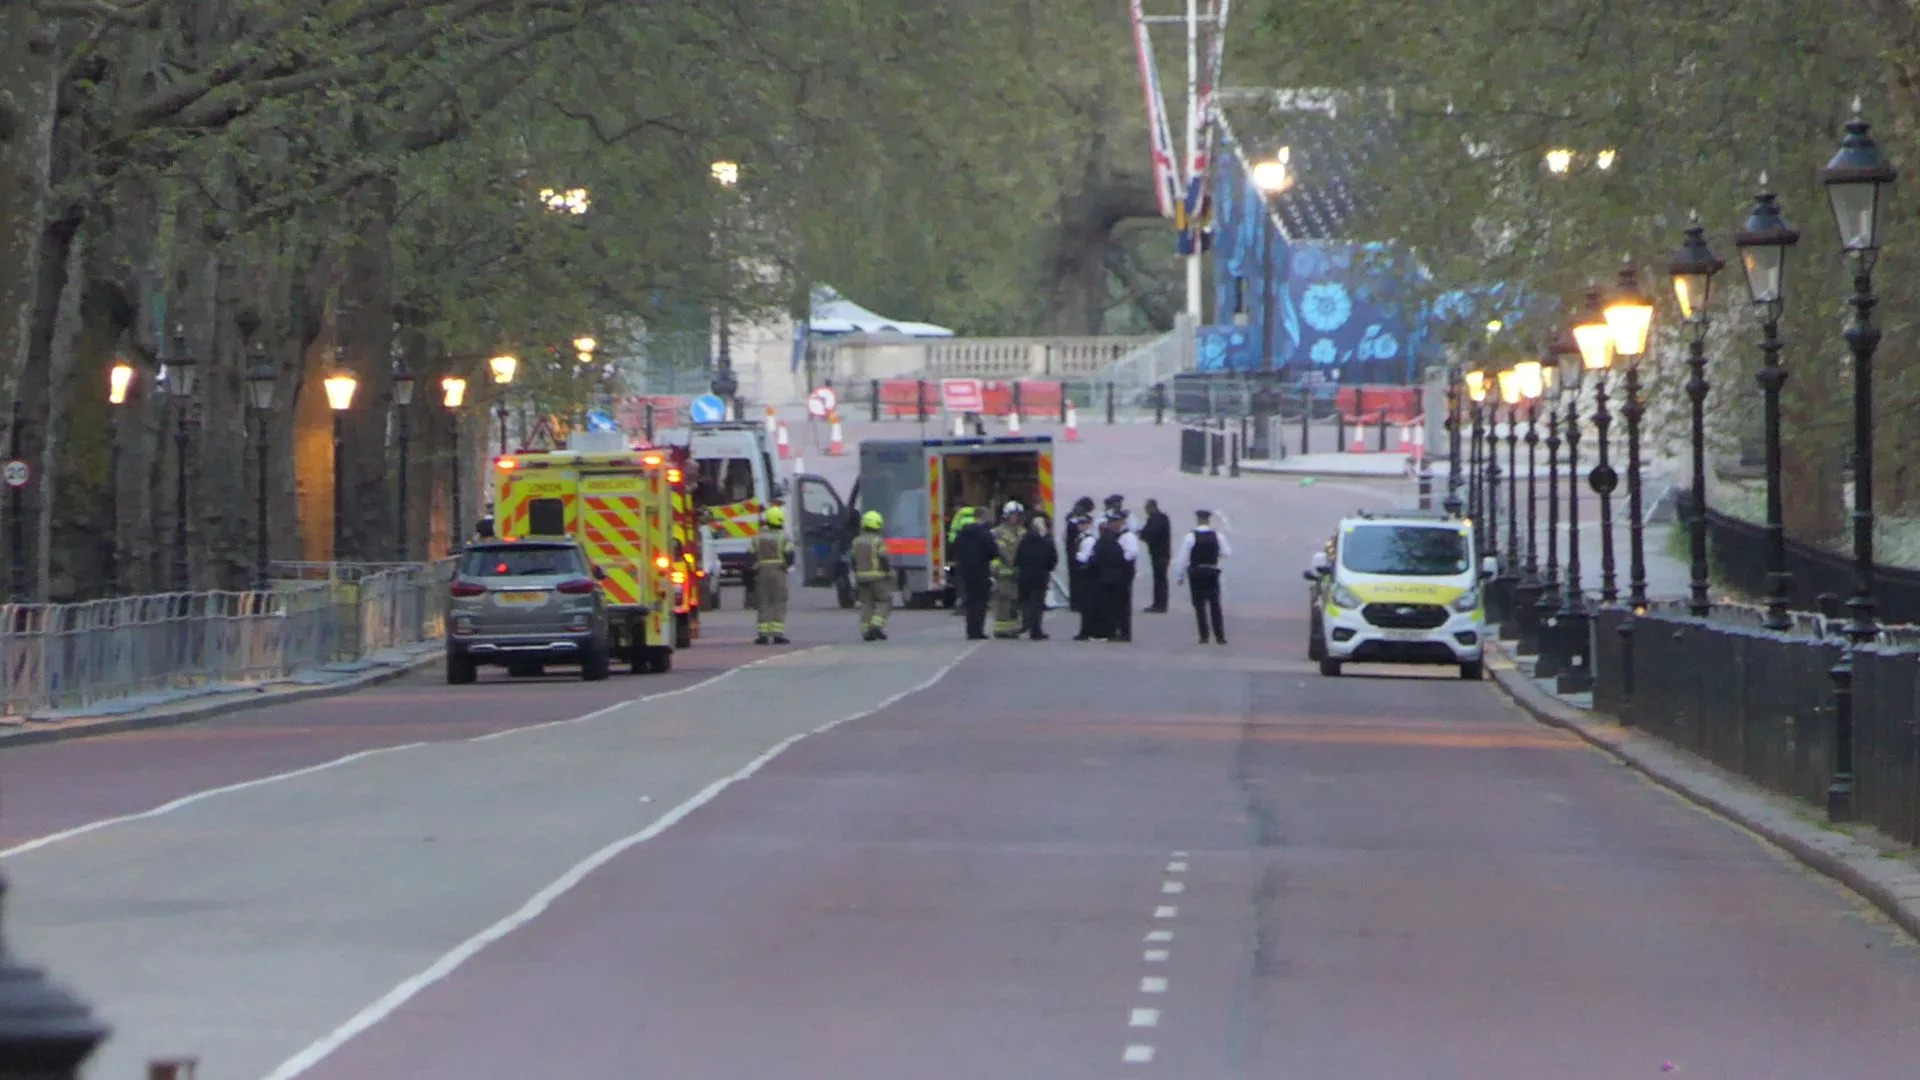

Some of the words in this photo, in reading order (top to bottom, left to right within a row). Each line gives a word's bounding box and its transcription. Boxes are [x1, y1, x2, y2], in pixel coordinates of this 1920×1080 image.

[8, 466, 26, 479] 20
[529, 483, 562, 492] LONDON
[1373, 586, 1438, 594] POLICE
